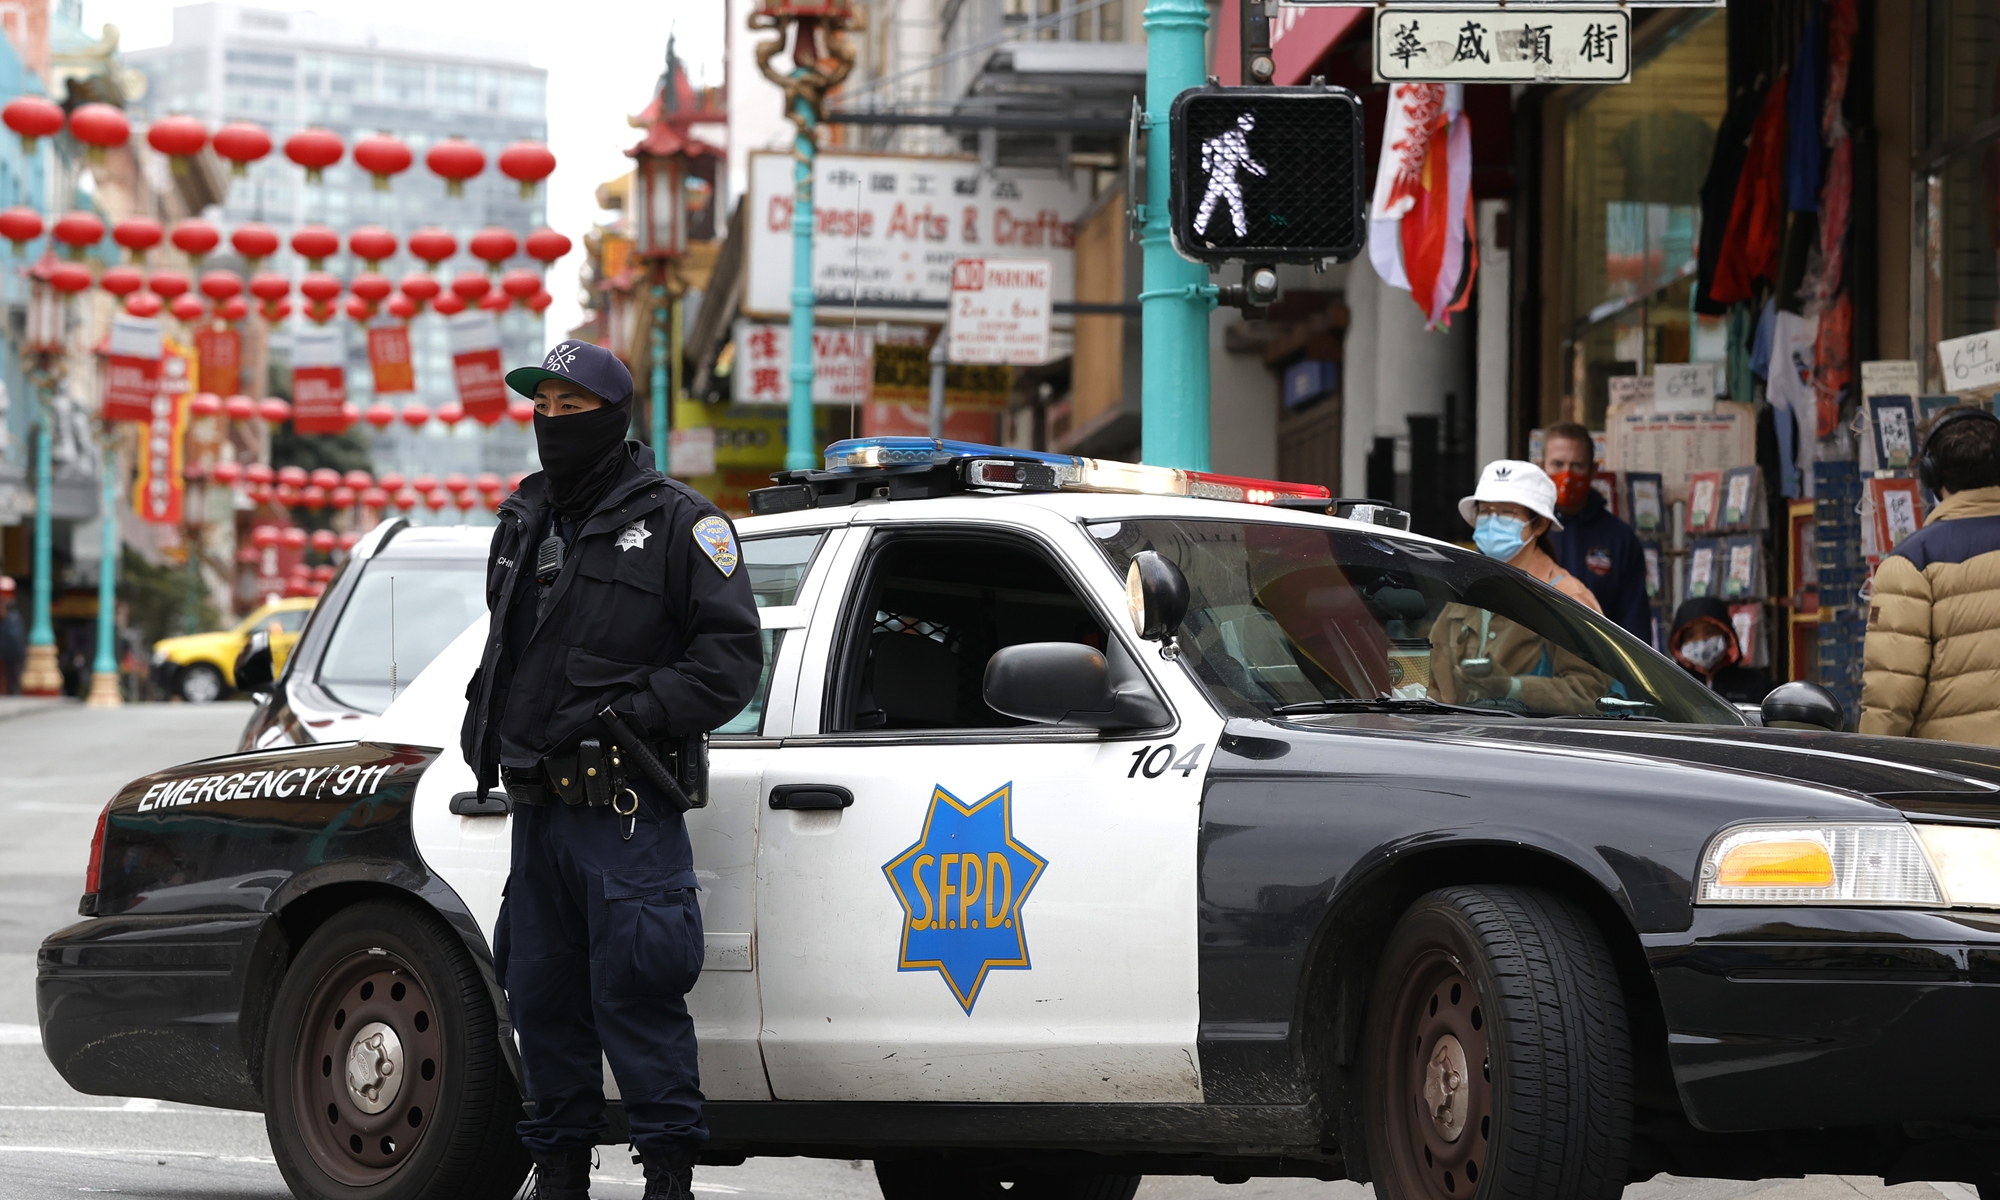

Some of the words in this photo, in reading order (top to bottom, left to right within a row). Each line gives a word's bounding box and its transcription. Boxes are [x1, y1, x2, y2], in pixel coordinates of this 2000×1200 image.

[1389, 20, 1618, 69] 華盛頓街
[887, 202, 948, 243] Arts
[961, 205, 979, 245] &
[993, 206, 1077, 250] Crafts
[989, 269, 1044, 289] PARKING
[1127, 743, 1206, 779] 104
[137, 767, 330, 813] EMERGENCY
[331, 764, 391, 797] 911
[910, 851, 1013, 931] S.F.P.D.
